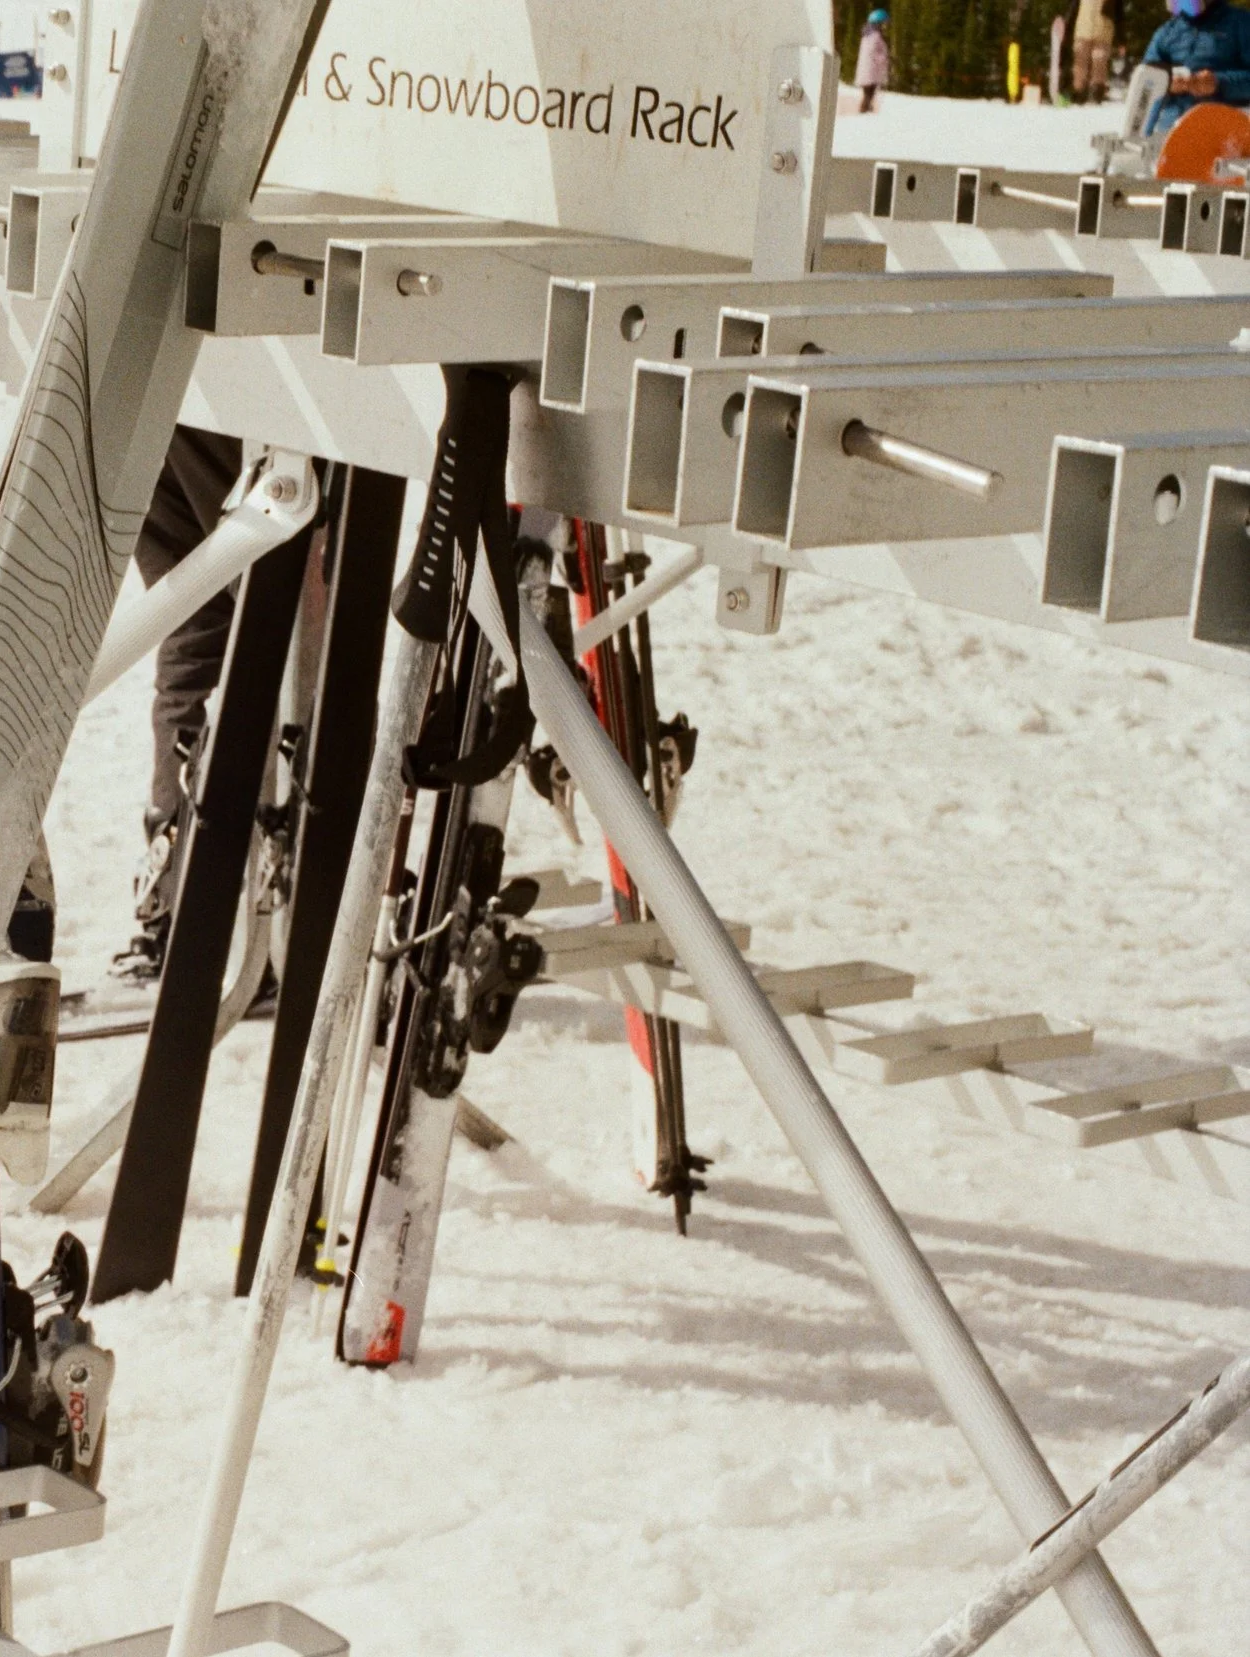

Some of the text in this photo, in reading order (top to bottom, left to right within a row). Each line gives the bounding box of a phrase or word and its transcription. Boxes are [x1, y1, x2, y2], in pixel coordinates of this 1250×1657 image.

[324, 52, 352, 102] &
[366, 56, 615, 135] Snowboard
[630, 84, 739, 152] Rack
[69, 1391, 85, 1433] 100
